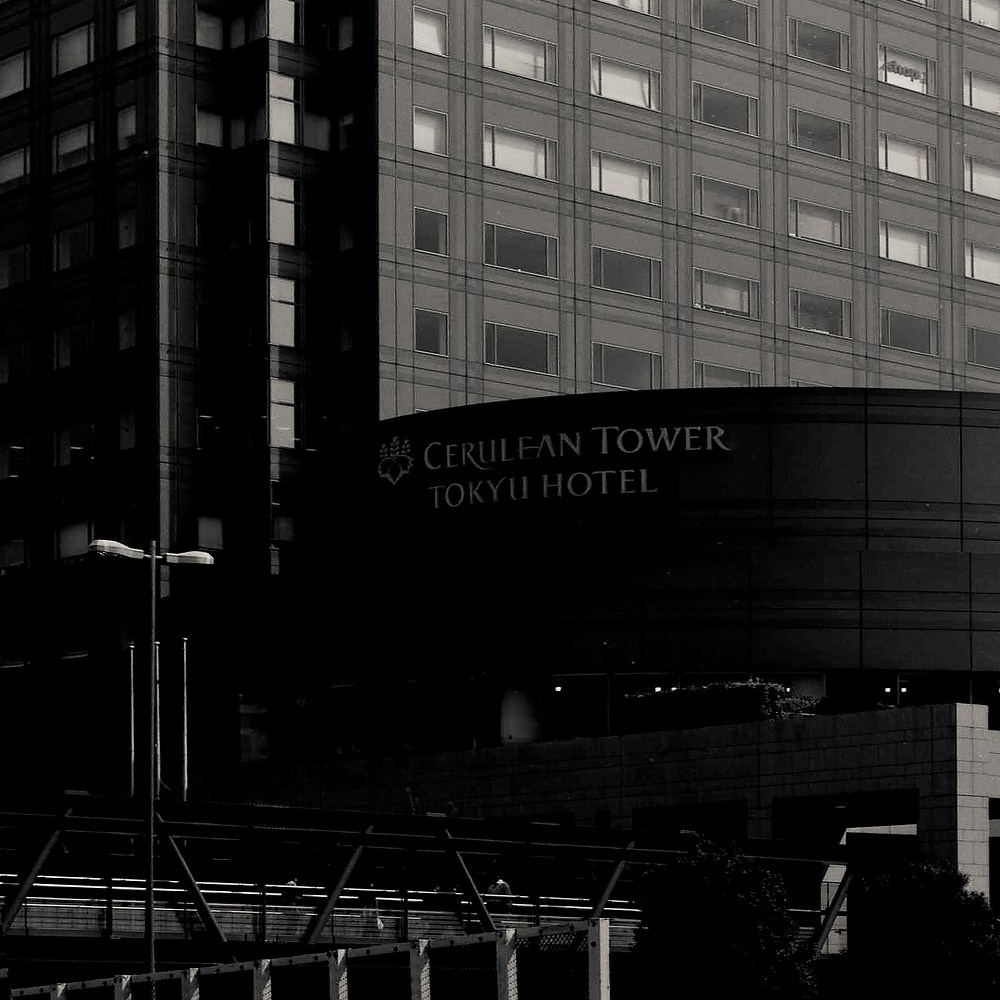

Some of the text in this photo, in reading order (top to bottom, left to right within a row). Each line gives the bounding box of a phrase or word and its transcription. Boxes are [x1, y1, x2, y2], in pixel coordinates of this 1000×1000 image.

[423, 425, 733, 471] CERULEAN TOWER
[428, 468, 659, 509] TOKYU HOTEL
